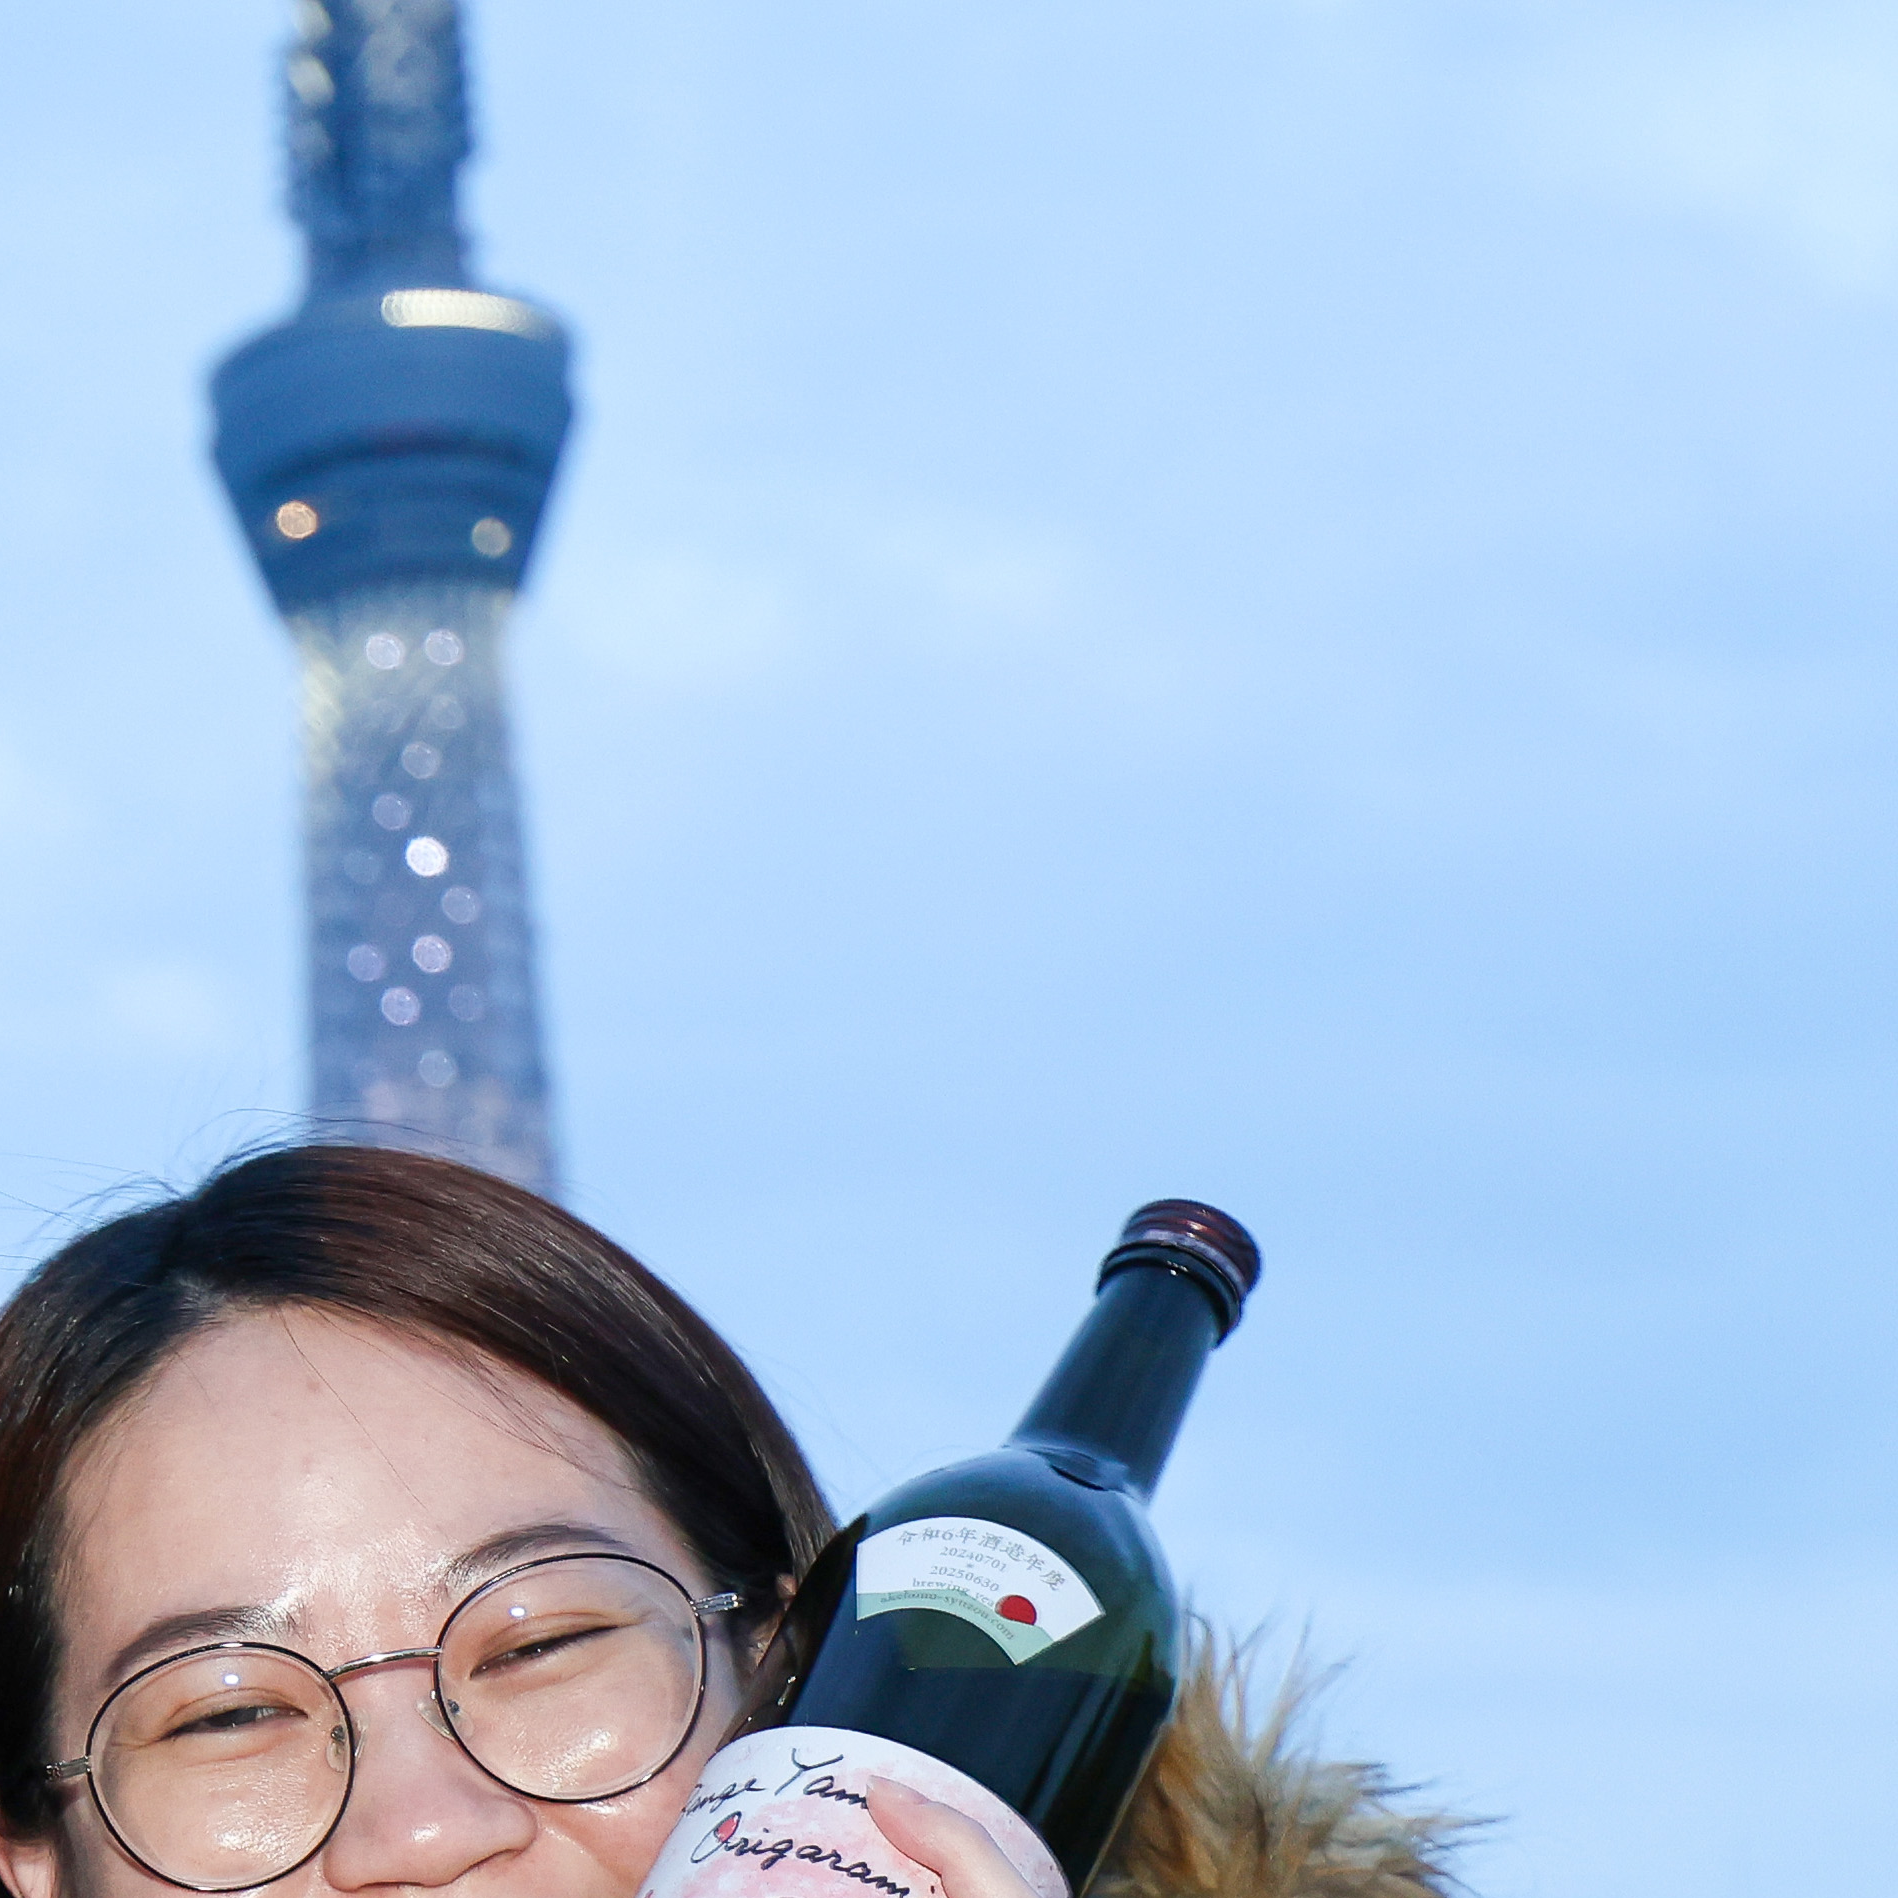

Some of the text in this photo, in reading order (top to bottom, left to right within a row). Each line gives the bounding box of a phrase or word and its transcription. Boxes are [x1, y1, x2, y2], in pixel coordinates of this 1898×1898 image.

[897, 1526, 1066, 1592] 令和6年酒造年度
[939, 1546, 1007, 1573] 20240701
[930, 1565, 1000, 1592] 20250630
[912, 1578, 997, 1608] brewing yea
